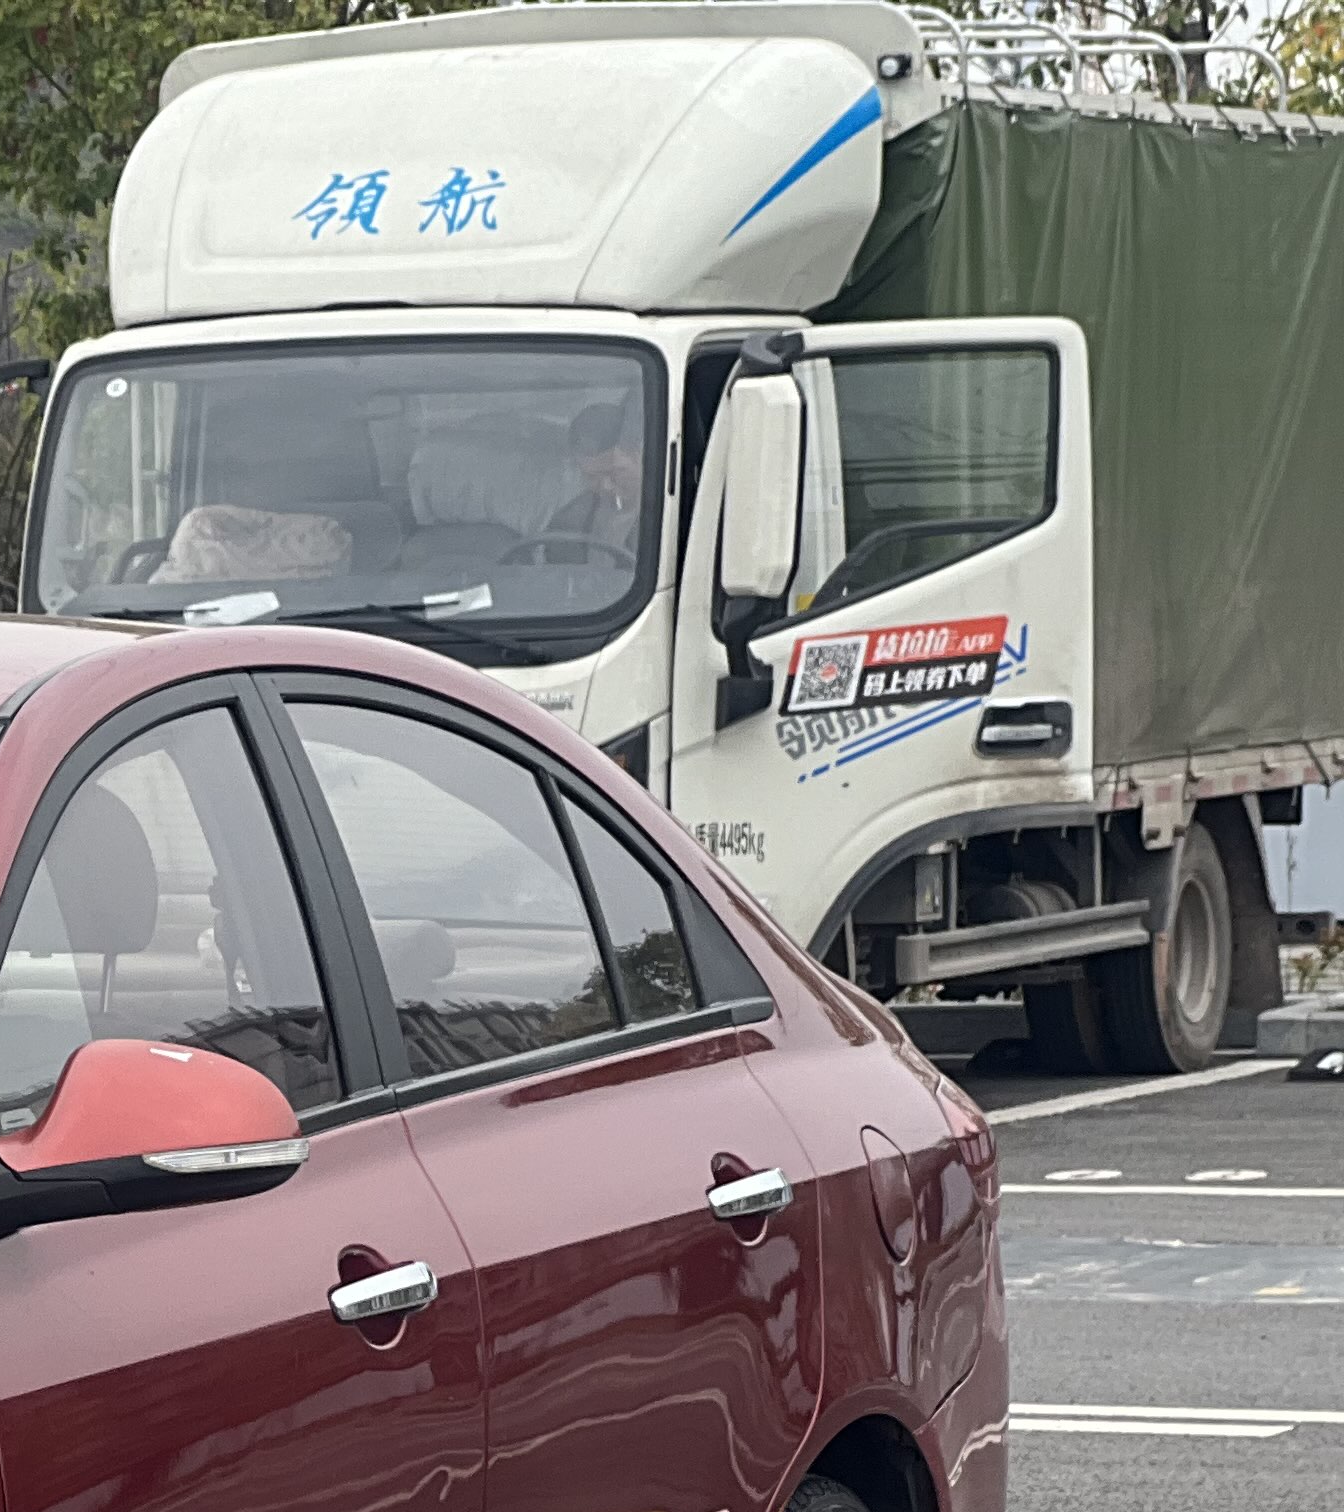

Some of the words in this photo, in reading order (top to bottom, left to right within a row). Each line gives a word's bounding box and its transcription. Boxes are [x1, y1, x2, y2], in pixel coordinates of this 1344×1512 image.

[959, 632, 995, 652] APP
[862, 659, 988, 698] 码上领券下单
[688, 821, 766, 864] 质量4495kg
